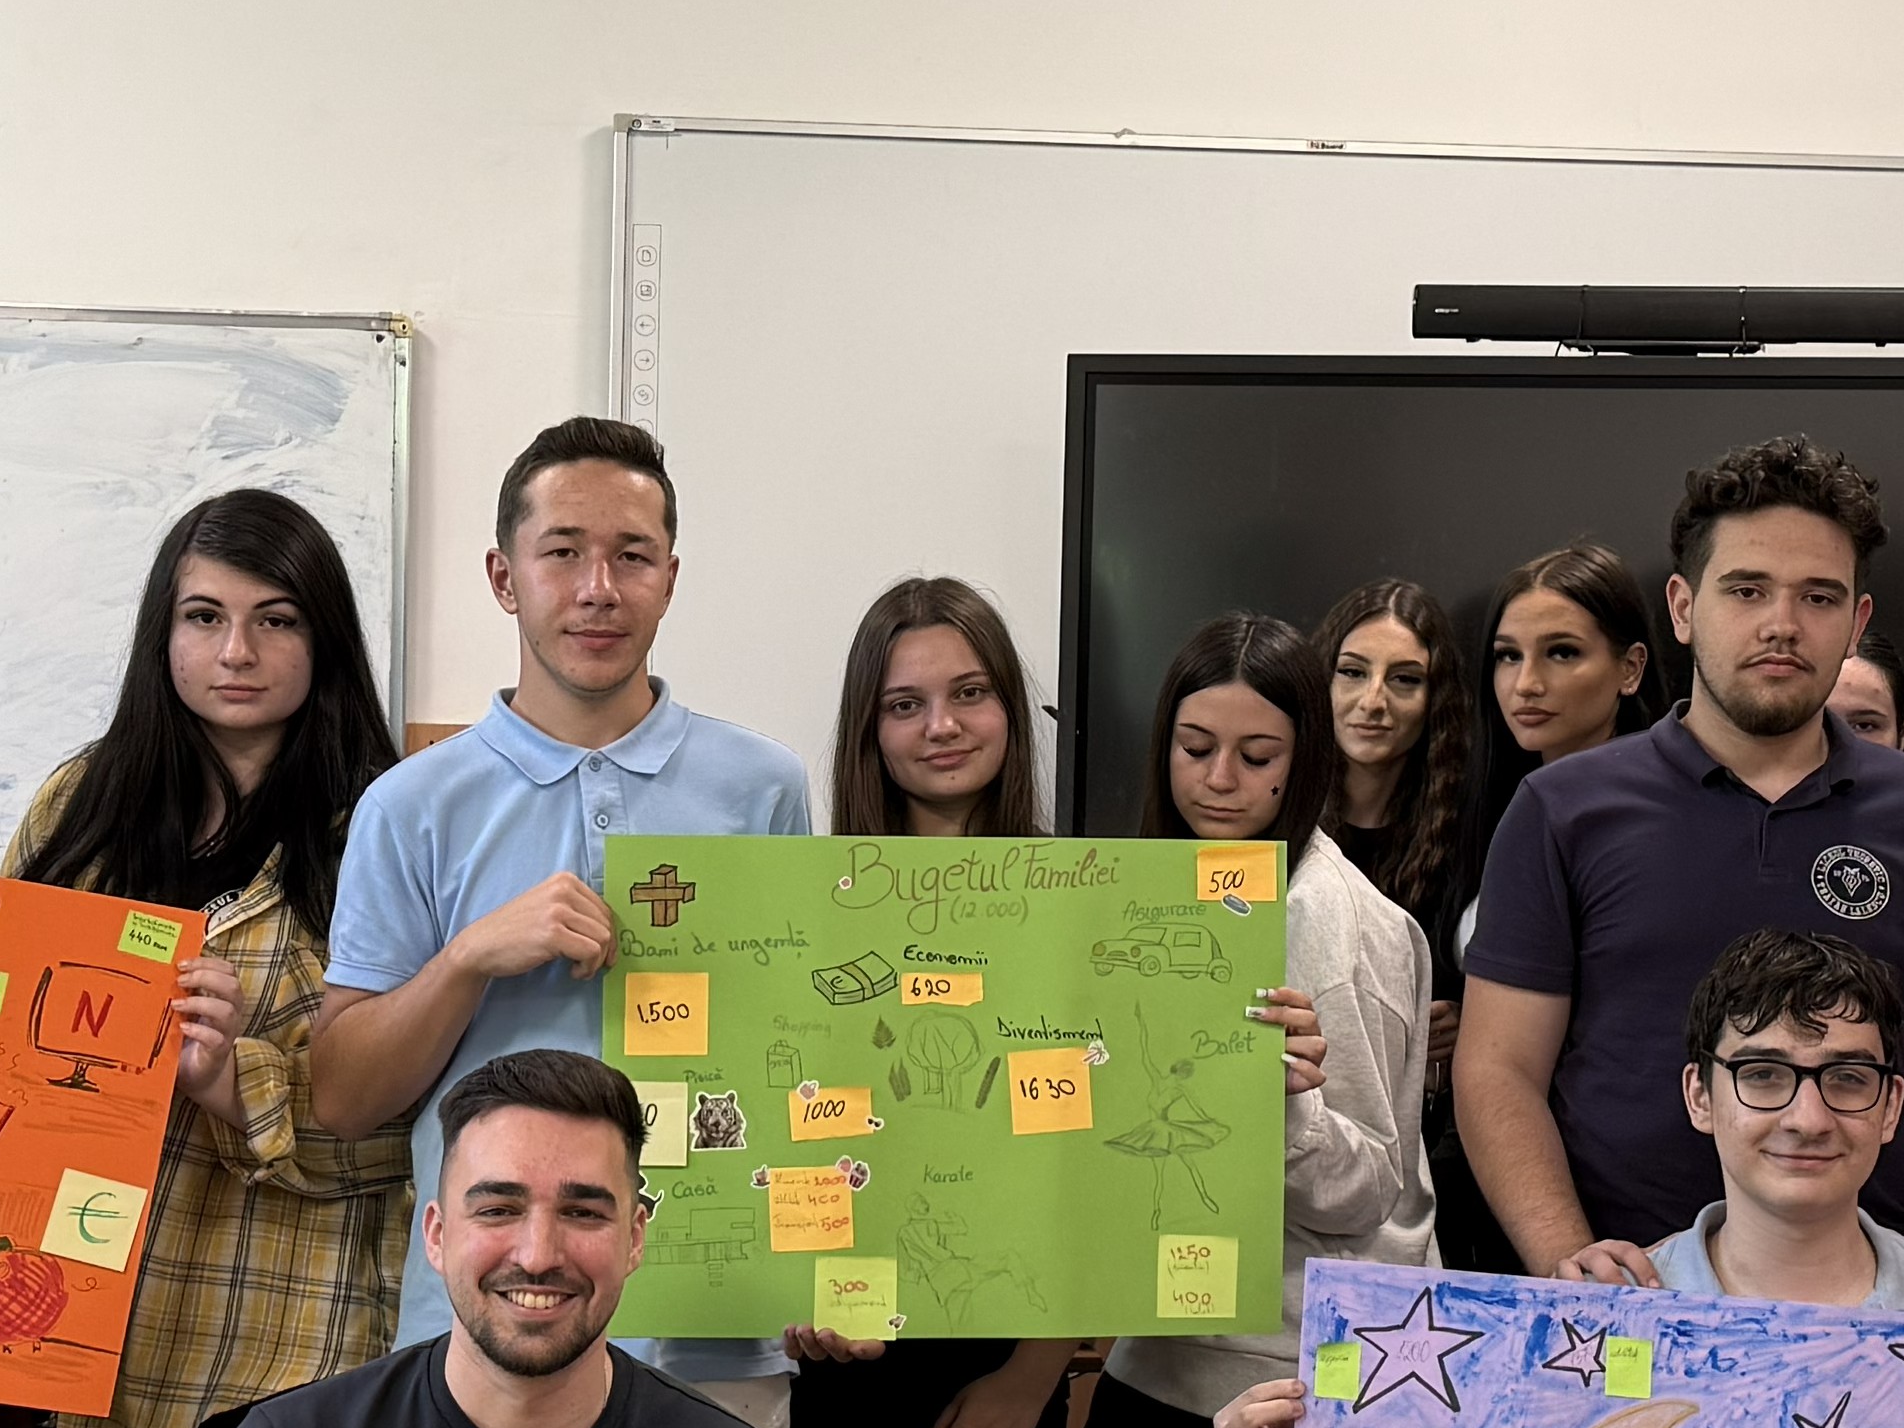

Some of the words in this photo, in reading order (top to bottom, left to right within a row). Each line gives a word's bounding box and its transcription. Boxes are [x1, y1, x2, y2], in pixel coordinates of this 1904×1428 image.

[831, 842, 1020, 935] Bugetul
[1024, 841, 1121, 890] Familiei
[1209, 869, 1245, 894] 500
[1122, 899, 1207, 922] Asigurare
[128, 928, 151, 946] 440
[691, 931, 717, 956] de
[71, 990, 114, 1038] N
[1191, 1030, 1257, 1059] Balet
[923, 1164, 974, 1184] Karate
[672, 1177, 719, 1199] Casă
[829, 1278, 869, 1296] 300
[1173, 1289, 1211, 1306] 400
